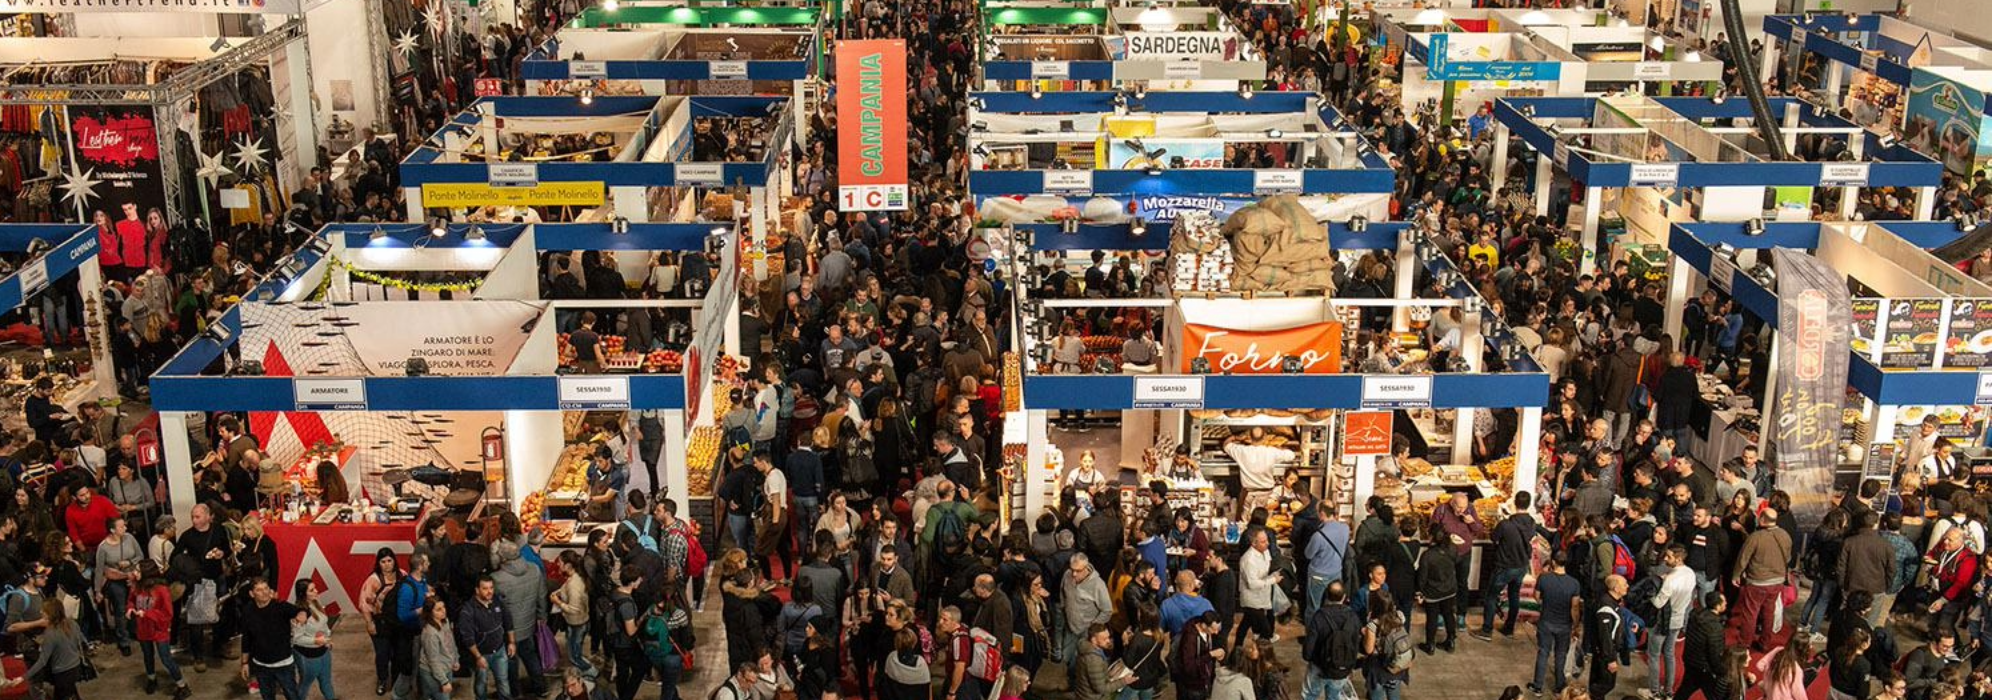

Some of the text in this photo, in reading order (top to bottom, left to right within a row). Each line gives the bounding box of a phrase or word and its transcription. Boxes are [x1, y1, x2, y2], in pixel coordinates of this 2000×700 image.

[1131, 36, 1222, 54] SARDEGNA
[860, 53, 884, 177] CAMPANIA
[79, 127, 123, 149] Leather
[429, 191, 456, 200] Ponte
[459, 190, 499, 200] Molinello
[529, 190, 556, 199] Ponte
[558, 189, 599, 199] Molinello
[845, 192, 854, 208] 1
[866, 191, 882, 208] C
[1143, 196, 1225, 211] Mozzarella
[423, 334, 494, 345] ARMATORE È LO
[411, 349, 454, 357] ZINGARO
[455, 349, 465, 357] DI
